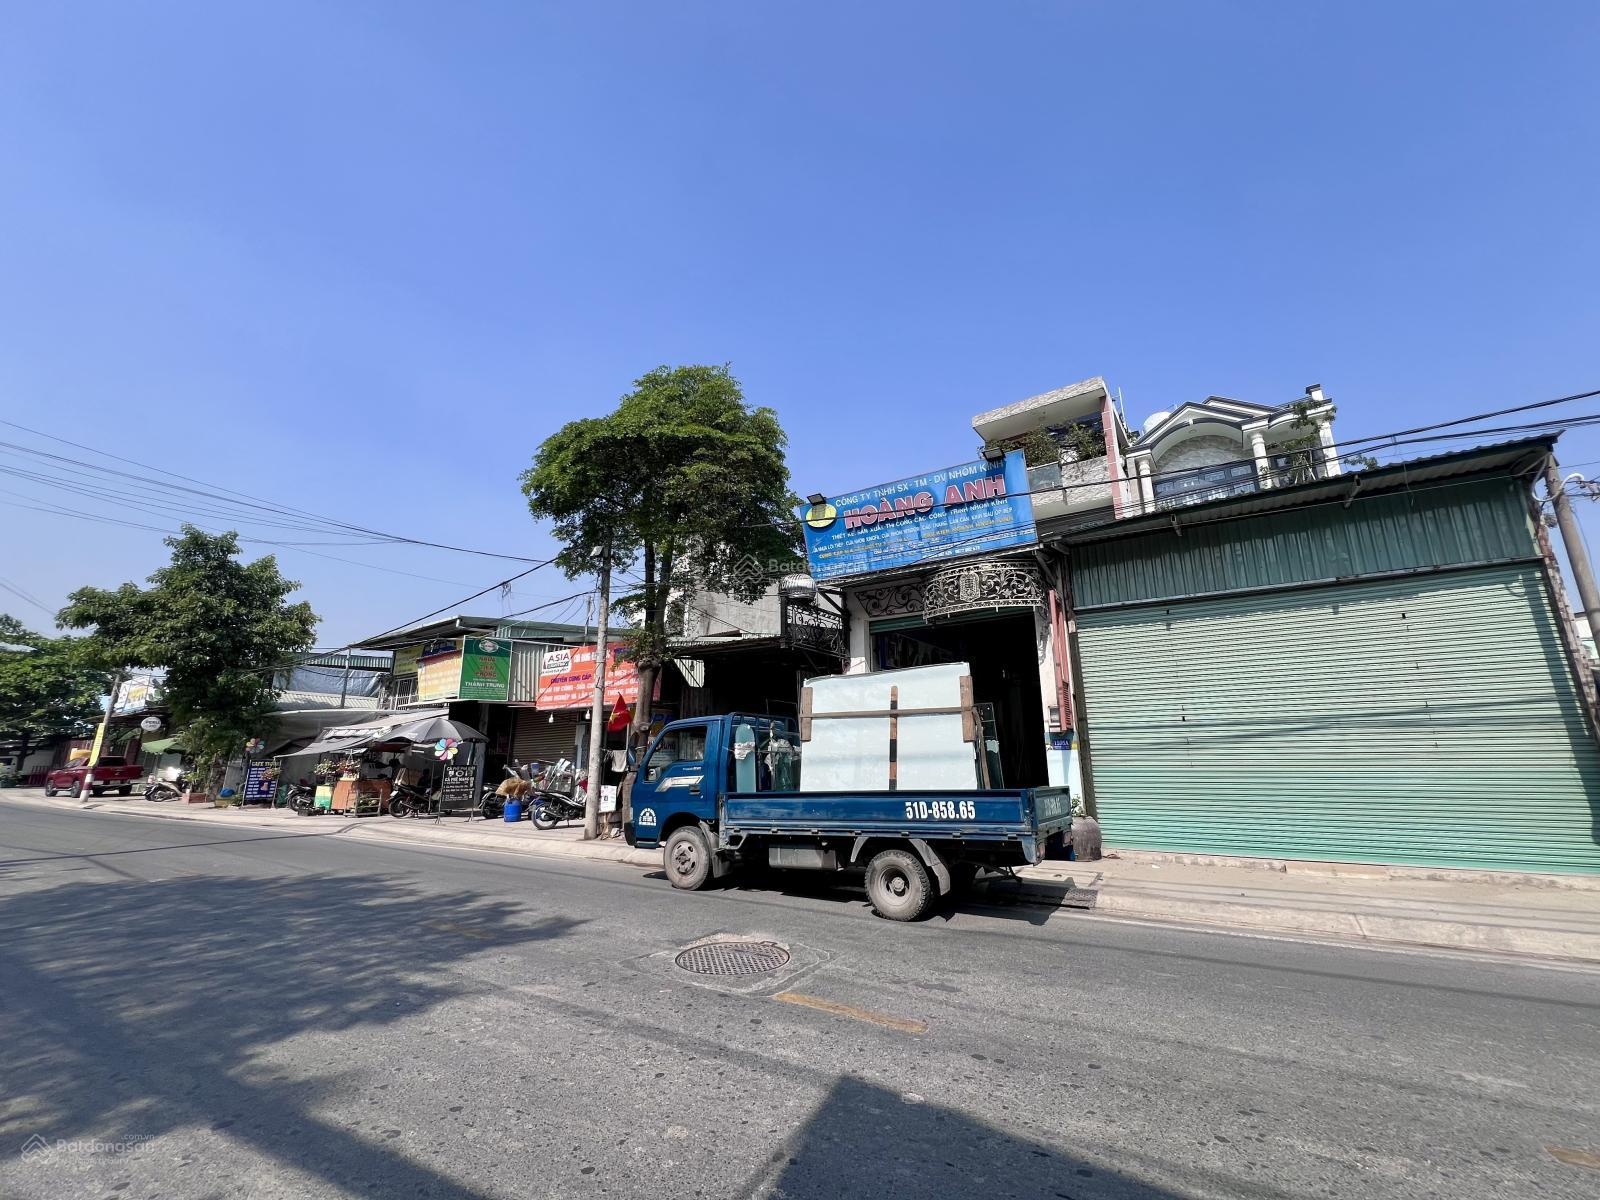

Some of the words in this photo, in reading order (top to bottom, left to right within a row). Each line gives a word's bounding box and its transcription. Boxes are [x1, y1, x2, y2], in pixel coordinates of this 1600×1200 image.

[835, 495, 859, 507] CÔNG
[874, 486, 896, 497] TNHH
[897, 483, 909, 492] SX
[914, 478, 927, 488] TM
[934, 473, 946, 483] DV
[843, 491, 934, 529] HOÀNG
[944, 474, 1006, 505] ANH
[547, 653, 570, 663] ASIA
[905, 800, 976, 820] 51D-858.65
